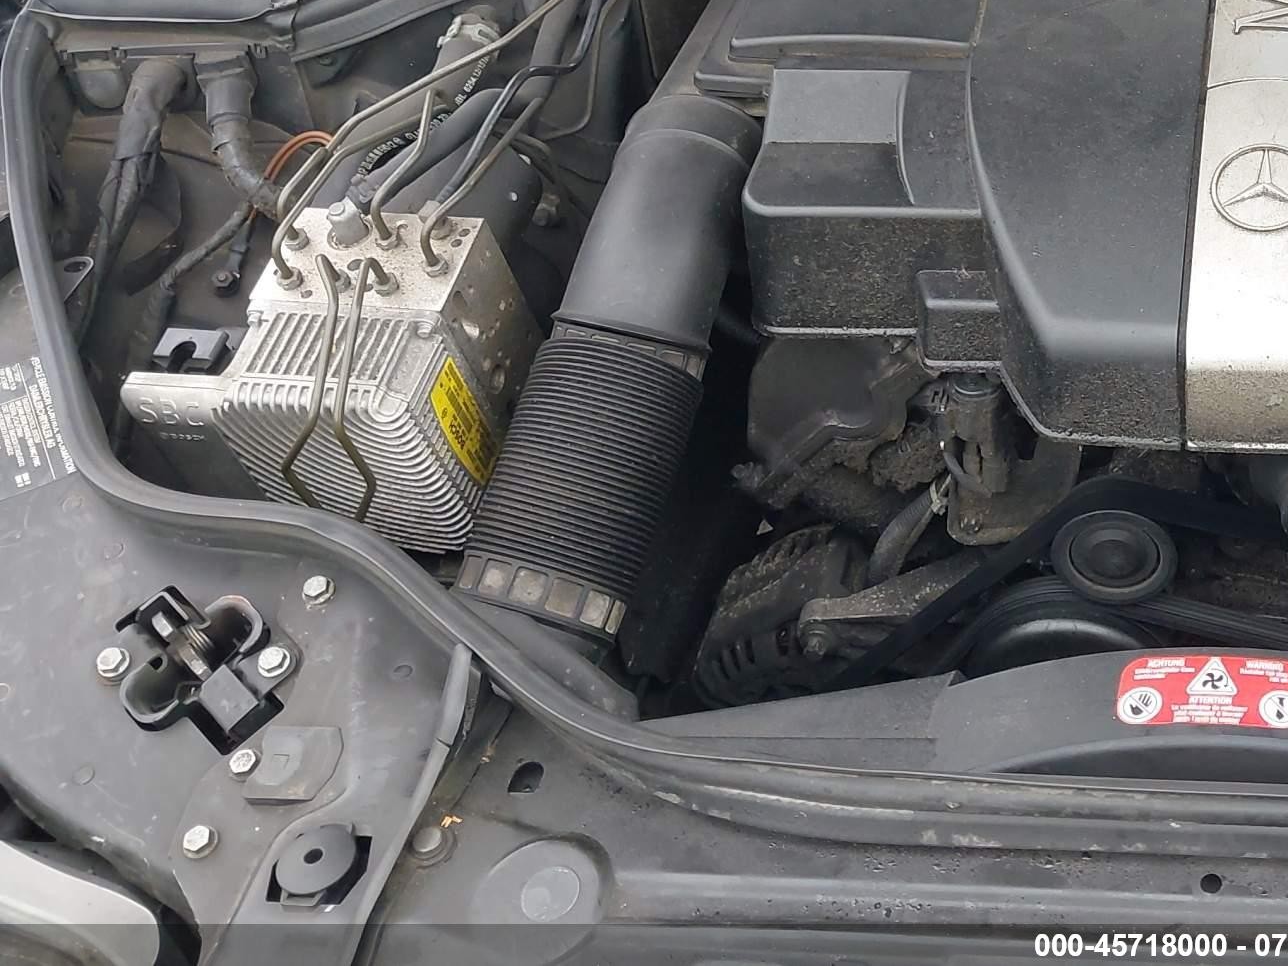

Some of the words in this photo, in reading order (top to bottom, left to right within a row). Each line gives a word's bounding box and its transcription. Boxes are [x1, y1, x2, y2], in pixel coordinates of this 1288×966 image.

[139, 397, 205, 427] SBC
[1147, 658, 1185, 668] ACHTUNG
[1188, 695, 1233, 705] ATTENTION
